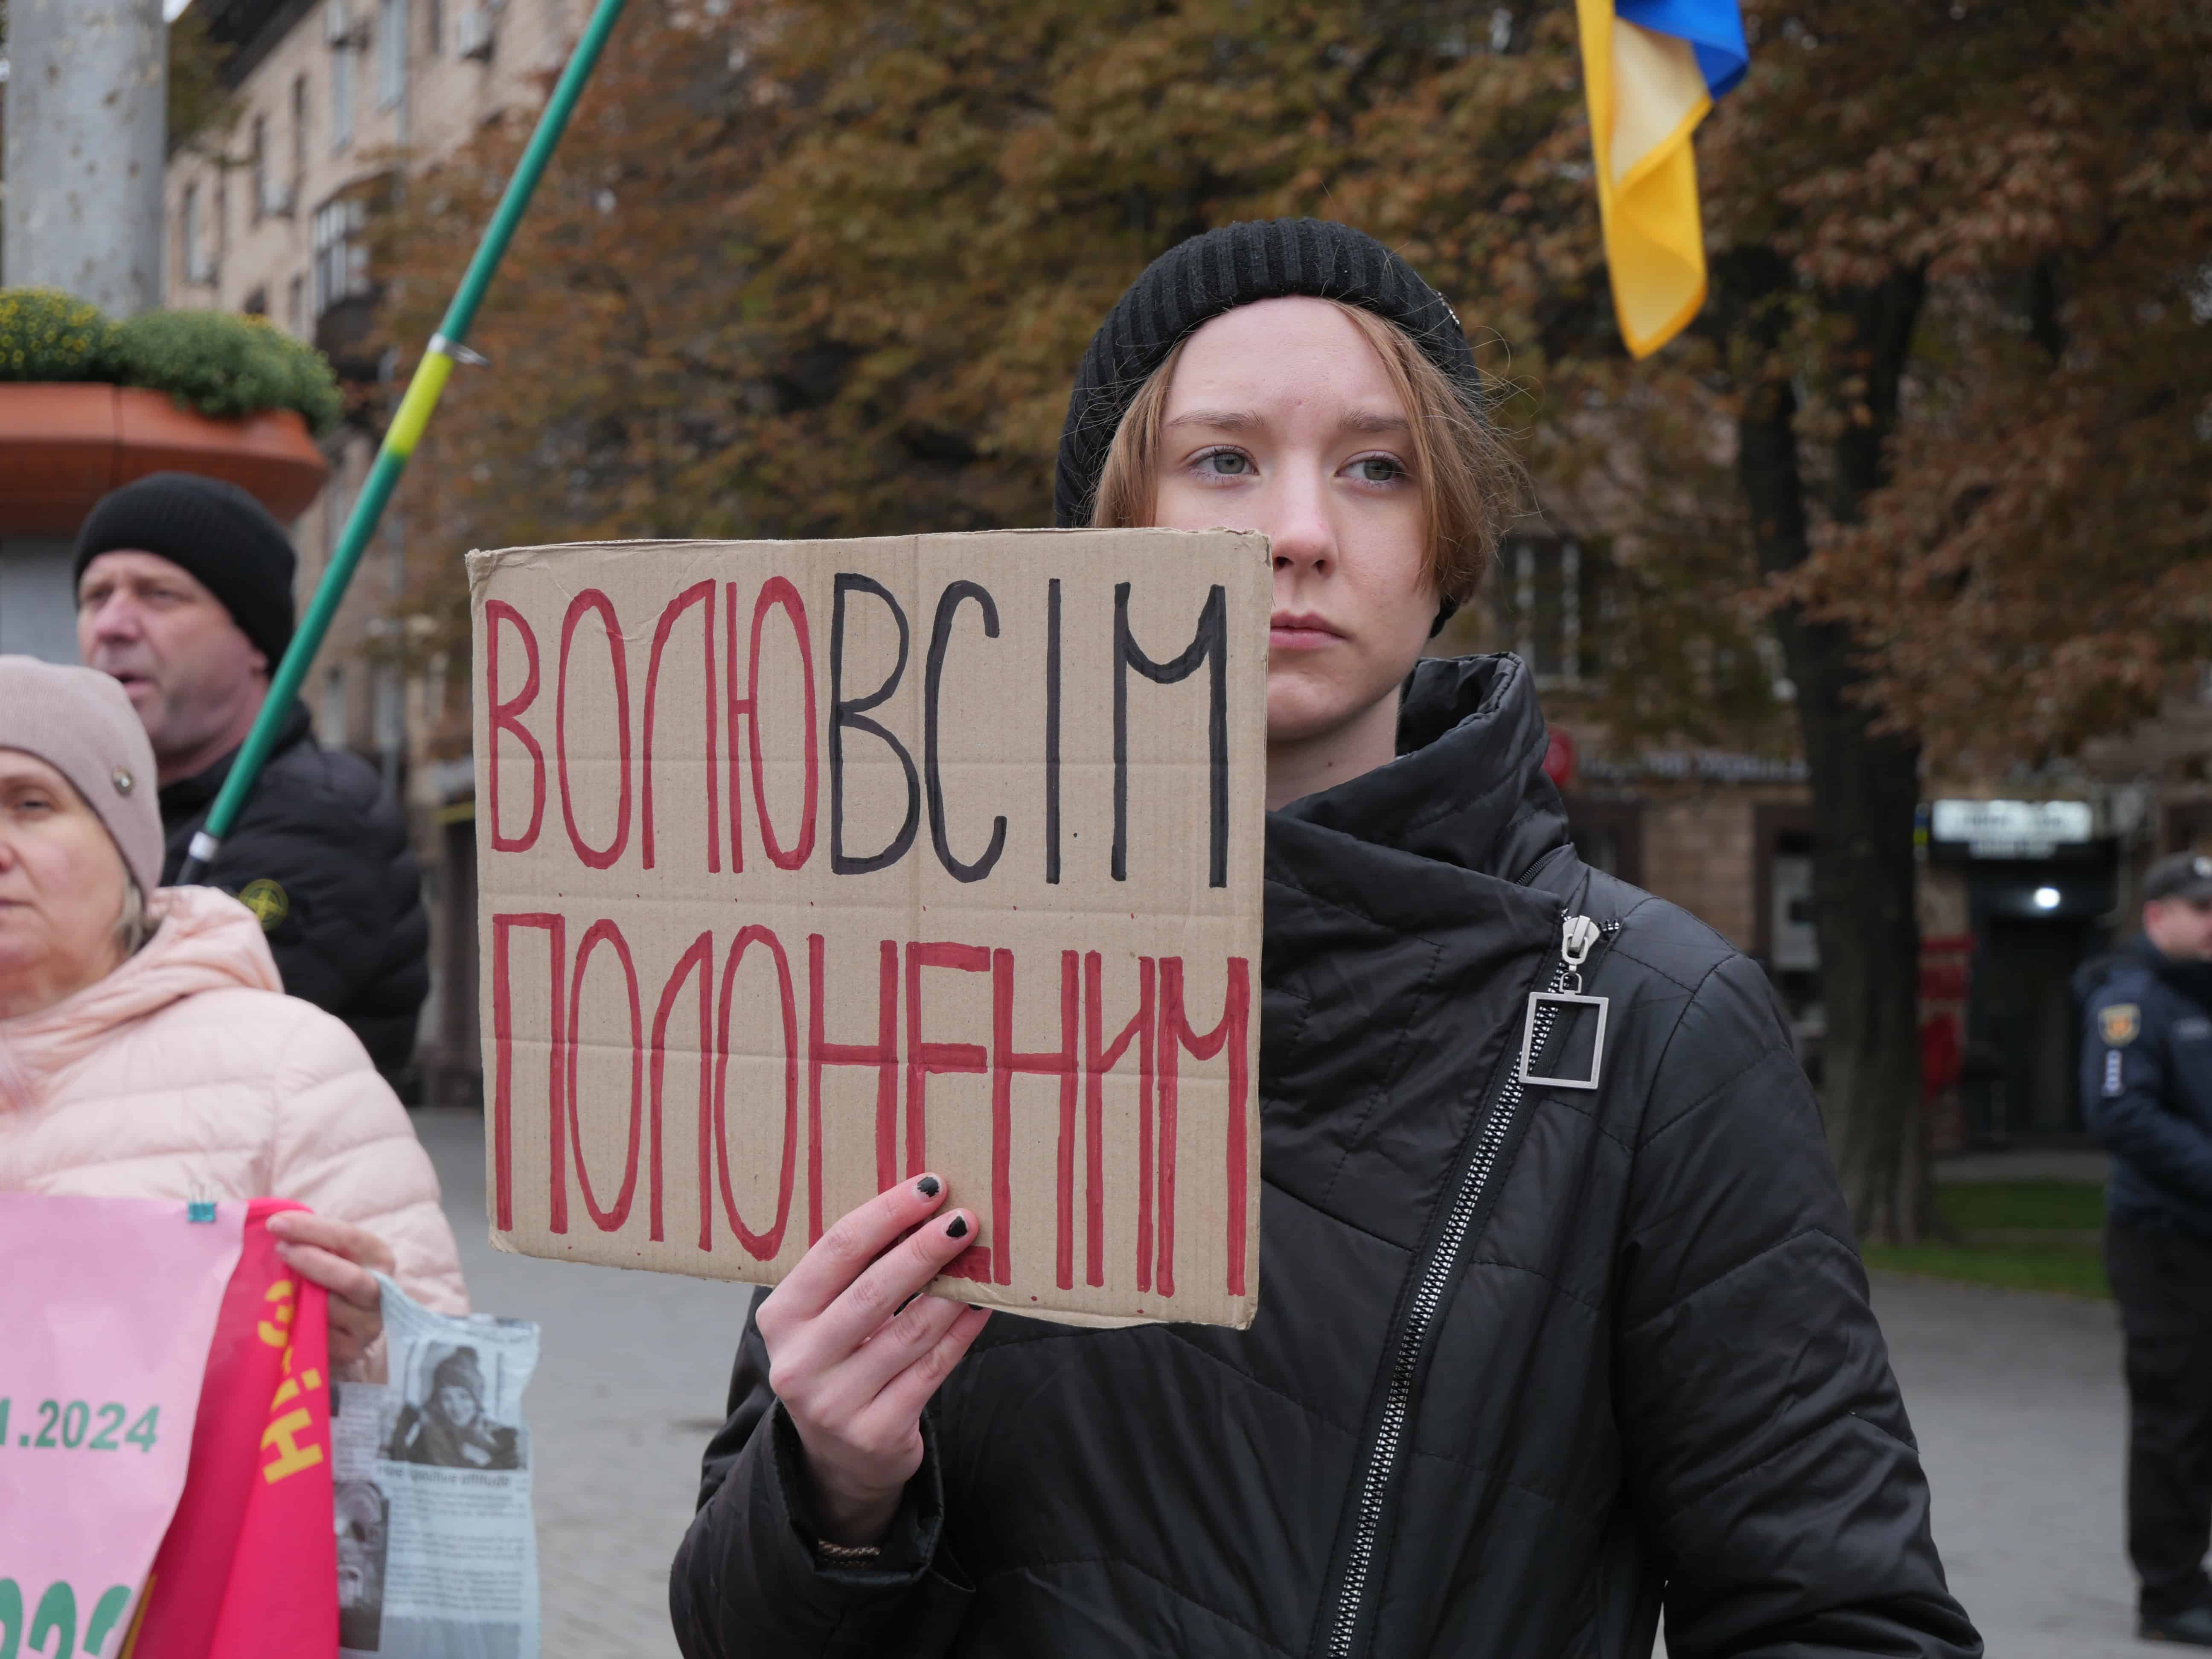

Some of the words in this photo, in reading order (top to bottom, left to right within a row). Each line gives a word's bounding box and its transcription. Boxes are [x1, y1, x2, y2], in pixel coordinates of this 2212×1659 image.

[485, 576, 818, 874] ВОЛЮ
[829, 573, 1229, 888] ВСІМ
[493, 913, 1250, 1298] ПОЛОНЕНИМ
